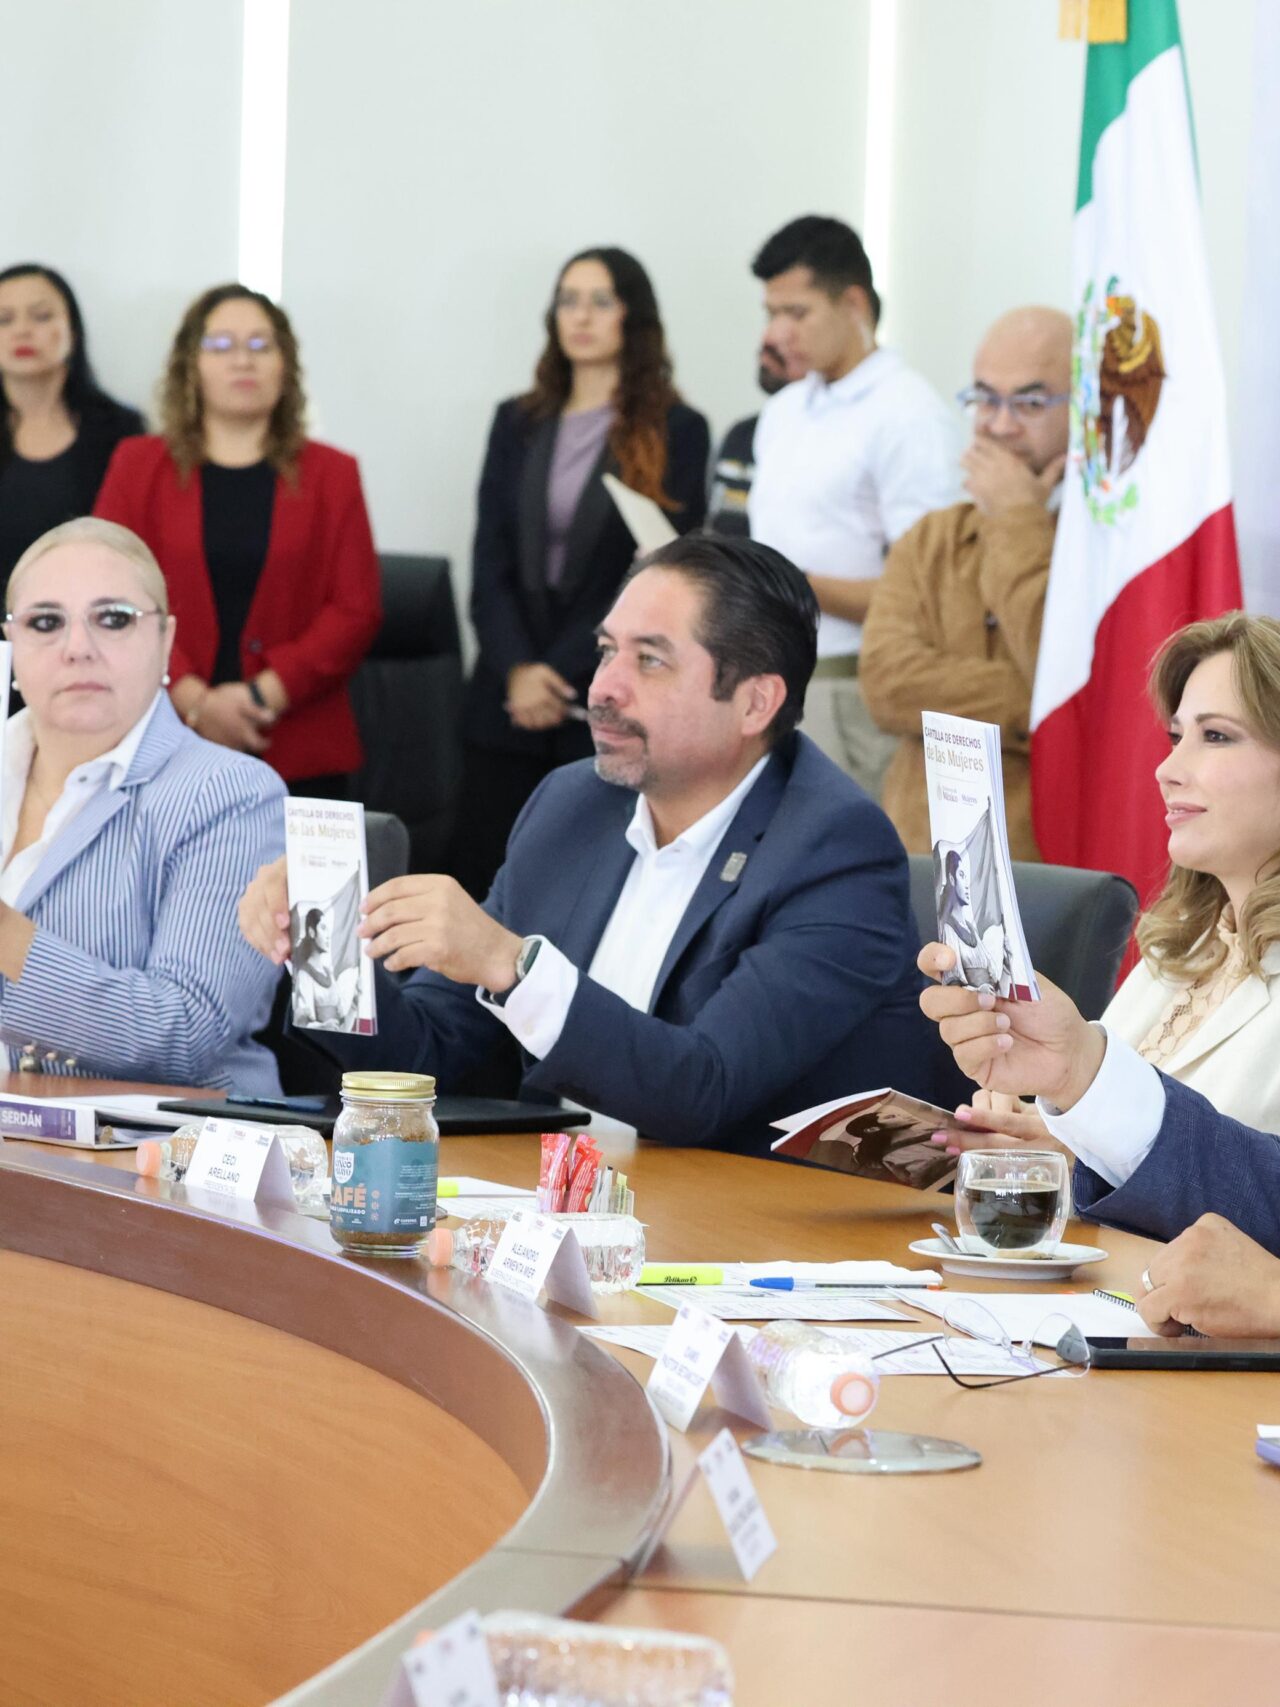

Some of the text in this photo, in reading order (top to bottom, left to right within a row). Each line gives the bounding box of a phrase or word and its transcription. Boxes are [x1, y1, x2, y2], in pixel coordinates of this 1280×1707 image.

[944, 732, 952, 744] DE
[952, 734, 982, 750] DERECHOS
[926, 741, 985, 773] de las Mujeres
[318, 823, 357, 841] Mujeres
[1, 1109, 43, 1128] SERDÁN
[207, 1166, 241, 1184] ARELLANO
[663, 1275, 690, 1284] Pelikan
